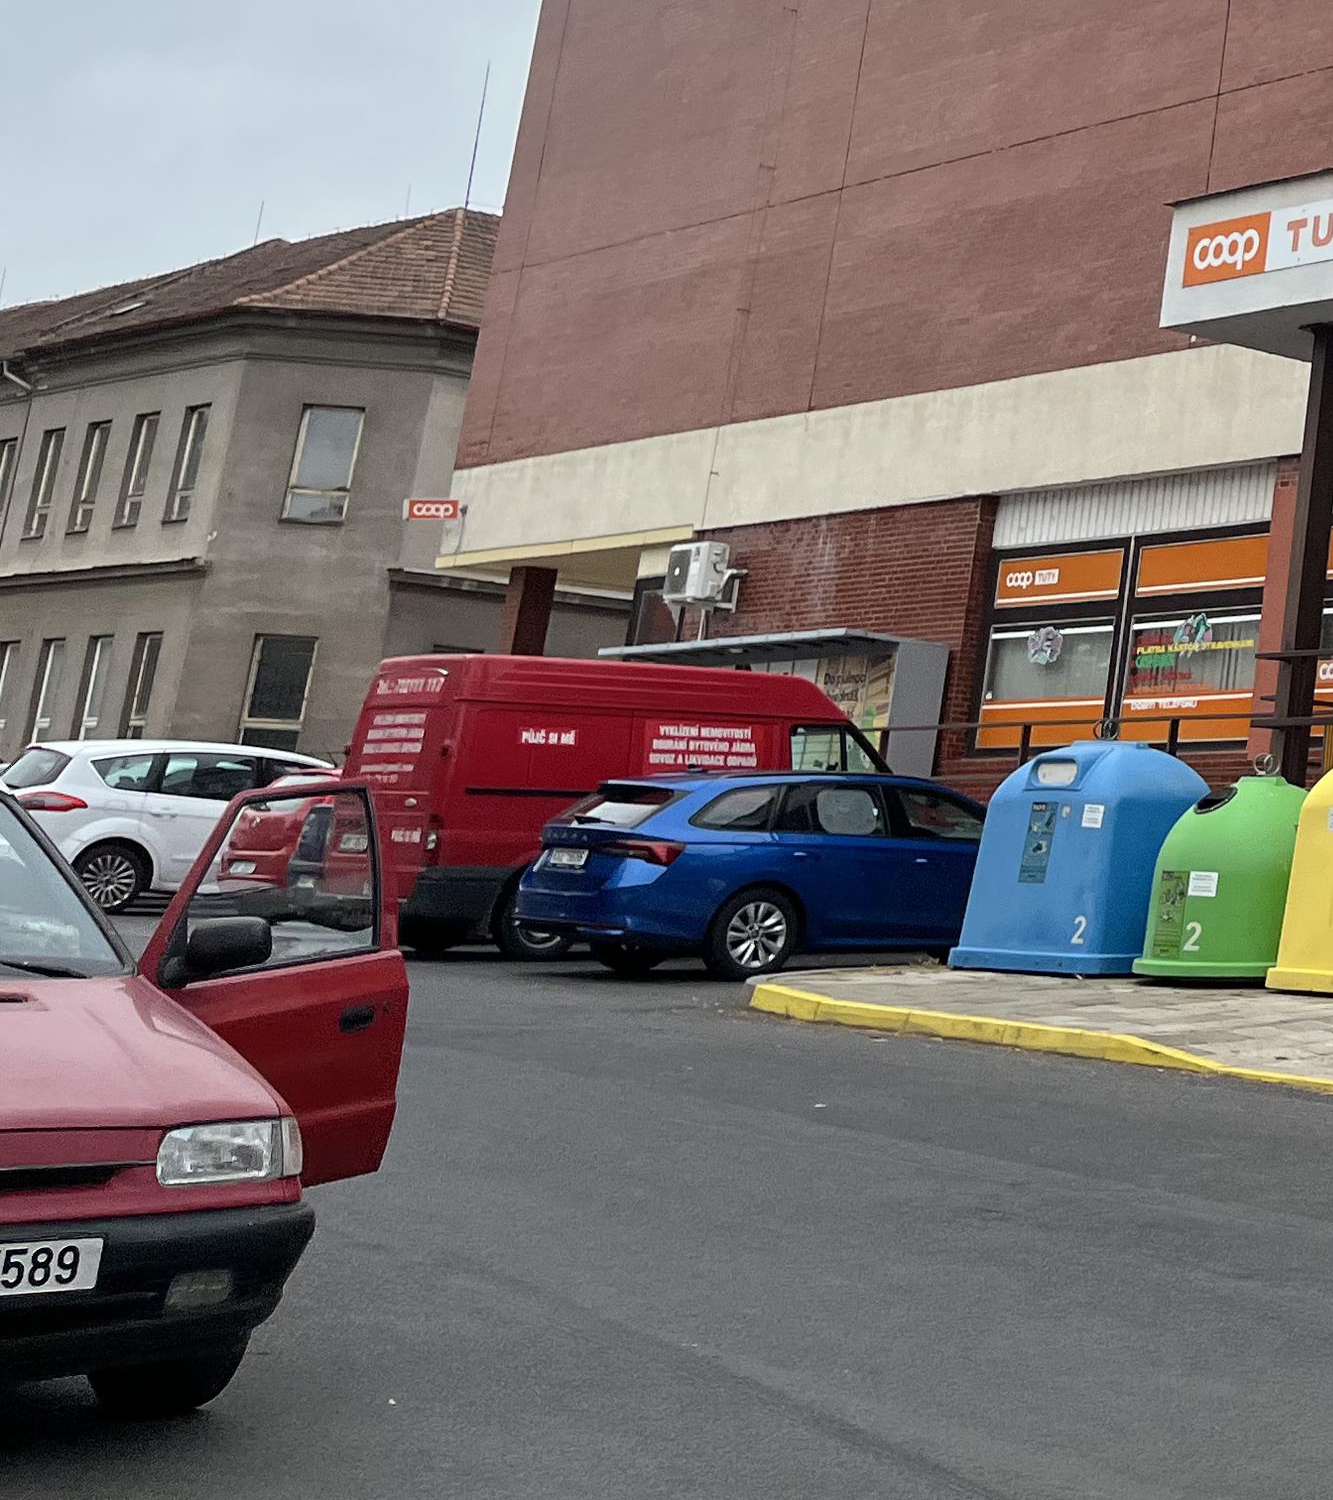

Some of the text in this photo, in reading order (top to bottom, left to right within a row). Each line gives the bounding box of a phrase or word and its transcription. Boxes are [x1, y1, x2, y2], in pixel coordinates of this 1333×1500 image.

[1193, 228, 1260, 271] coop
[413, 503, 453, 518] coop
[1006, 571, 1033, 589] coop
[1071, 915, 1088, 945] 2
[1183, 921, 1202, 952] 2
[0, 1244, 81, 1290] 589
